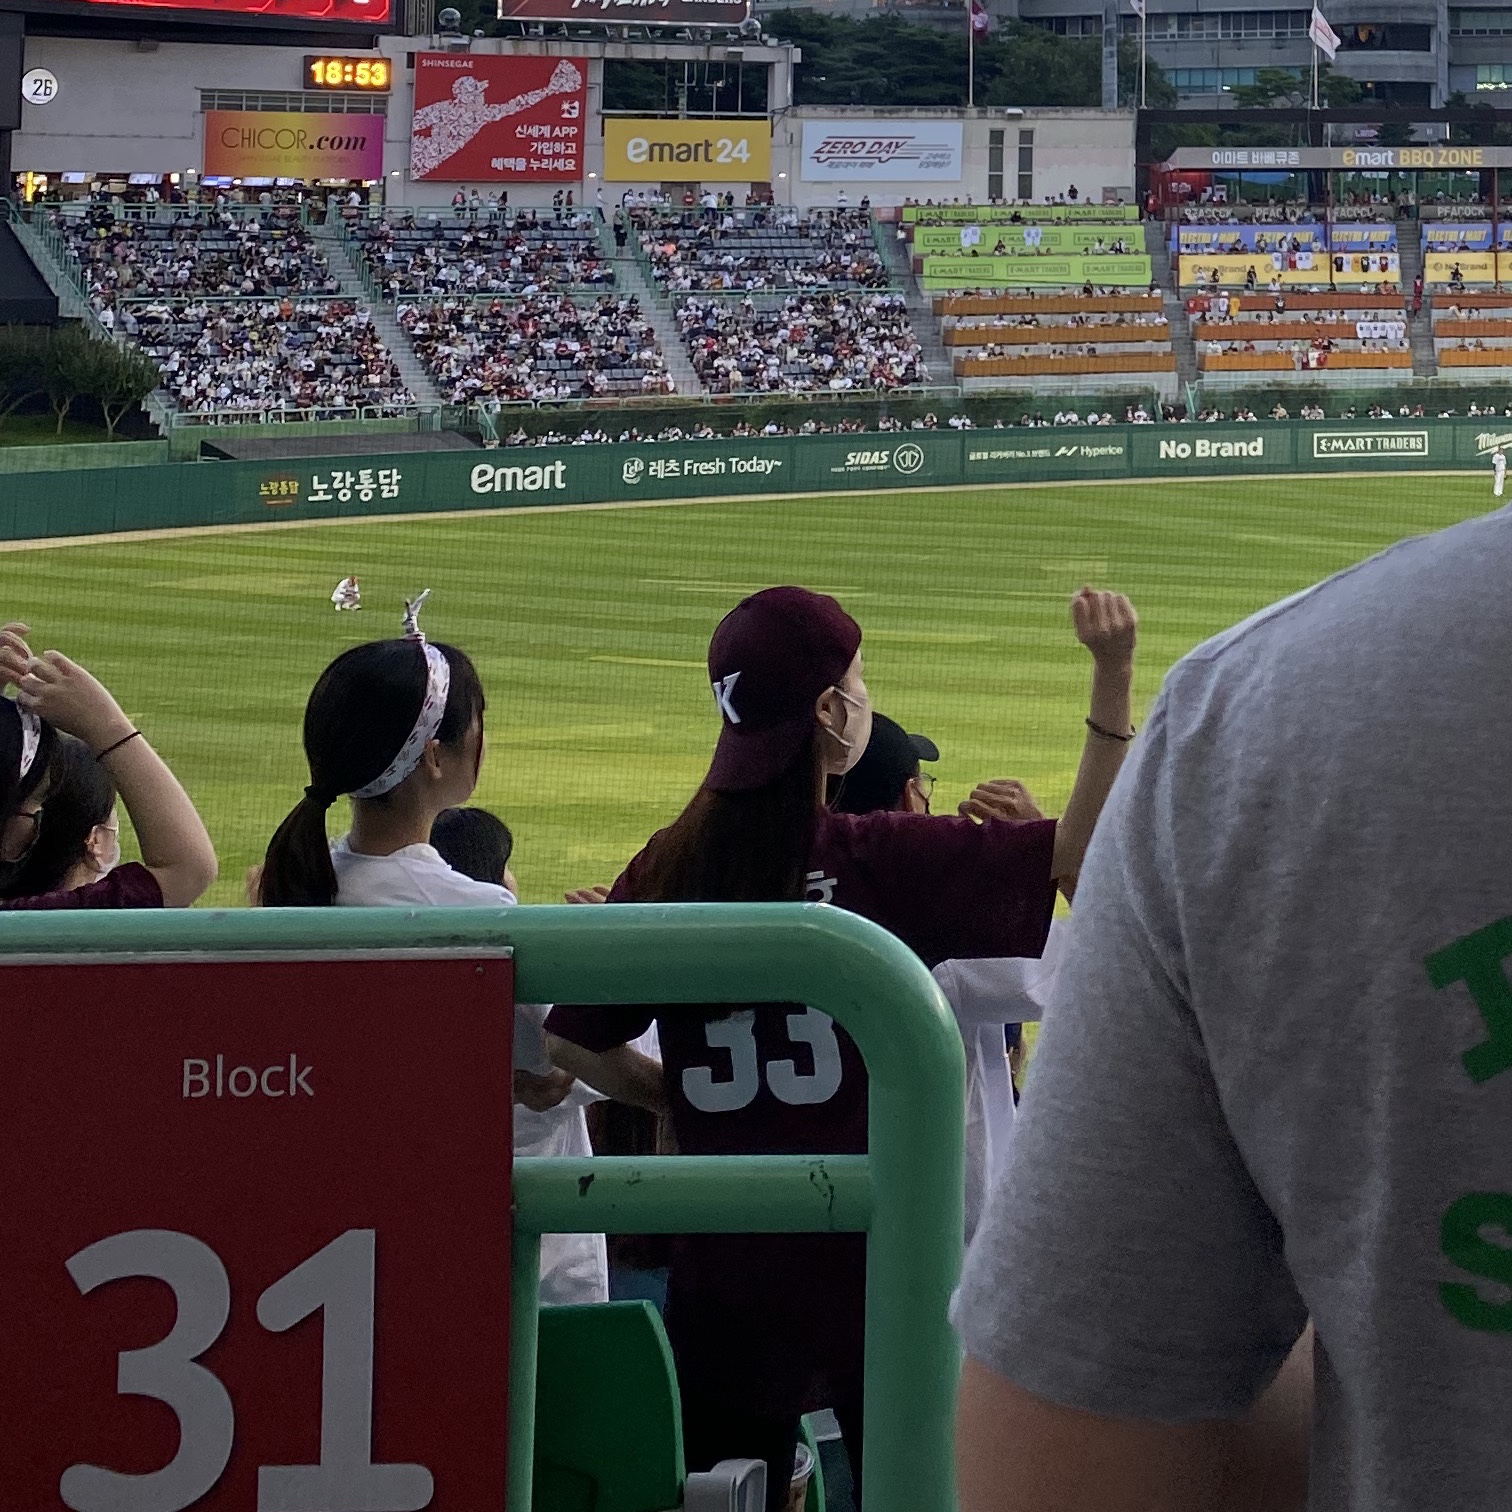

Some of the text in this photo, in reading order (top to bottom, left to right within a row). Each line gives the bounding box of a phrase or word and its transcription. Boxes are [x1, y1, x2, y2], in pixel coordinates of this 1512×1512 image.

[311, 60, 388, 85] 18:53
[422, 59, 474, 69] SHINSEGAE
[33, 79, 52, 96] 26
[221, 127, 366, 151] CHICOR.com
[515, 125, 577, 138] 신세계 APP
[530, 141, 576, 155] 가입하고
[814, 141, 908, 155] ZERO DAY
[490, 156, 576, 171] 혜택을 누리세요
[1212, 151, 1299, 165] 이마트 바베큐존
[1343, 149, 1483, 166] emart BBQ ZONE
[1437, 206, 1485, 217] PEACOCK
[1080, 445, 1124, 457] Hyperice
[1159, 437, 1264, 459] No Brand
[1376, 437, 1423, 450] TRADERS
[845, 451, 890, 466] SIDAS
[649, 459, 681, 479] 레츠
[683, 457, 725, 475] Fresh
[307, 468, 401, 502] 노랑통닭
[470, 460, 567, 494] emart
[259, 478, 299, 496] 노랑통닭
[713, 671, 742, 725] K
[682, 1006, 843, 1113] 33
[183, 1054, 315, 1100] Block
[59, 1227, 434, 1512] 31
